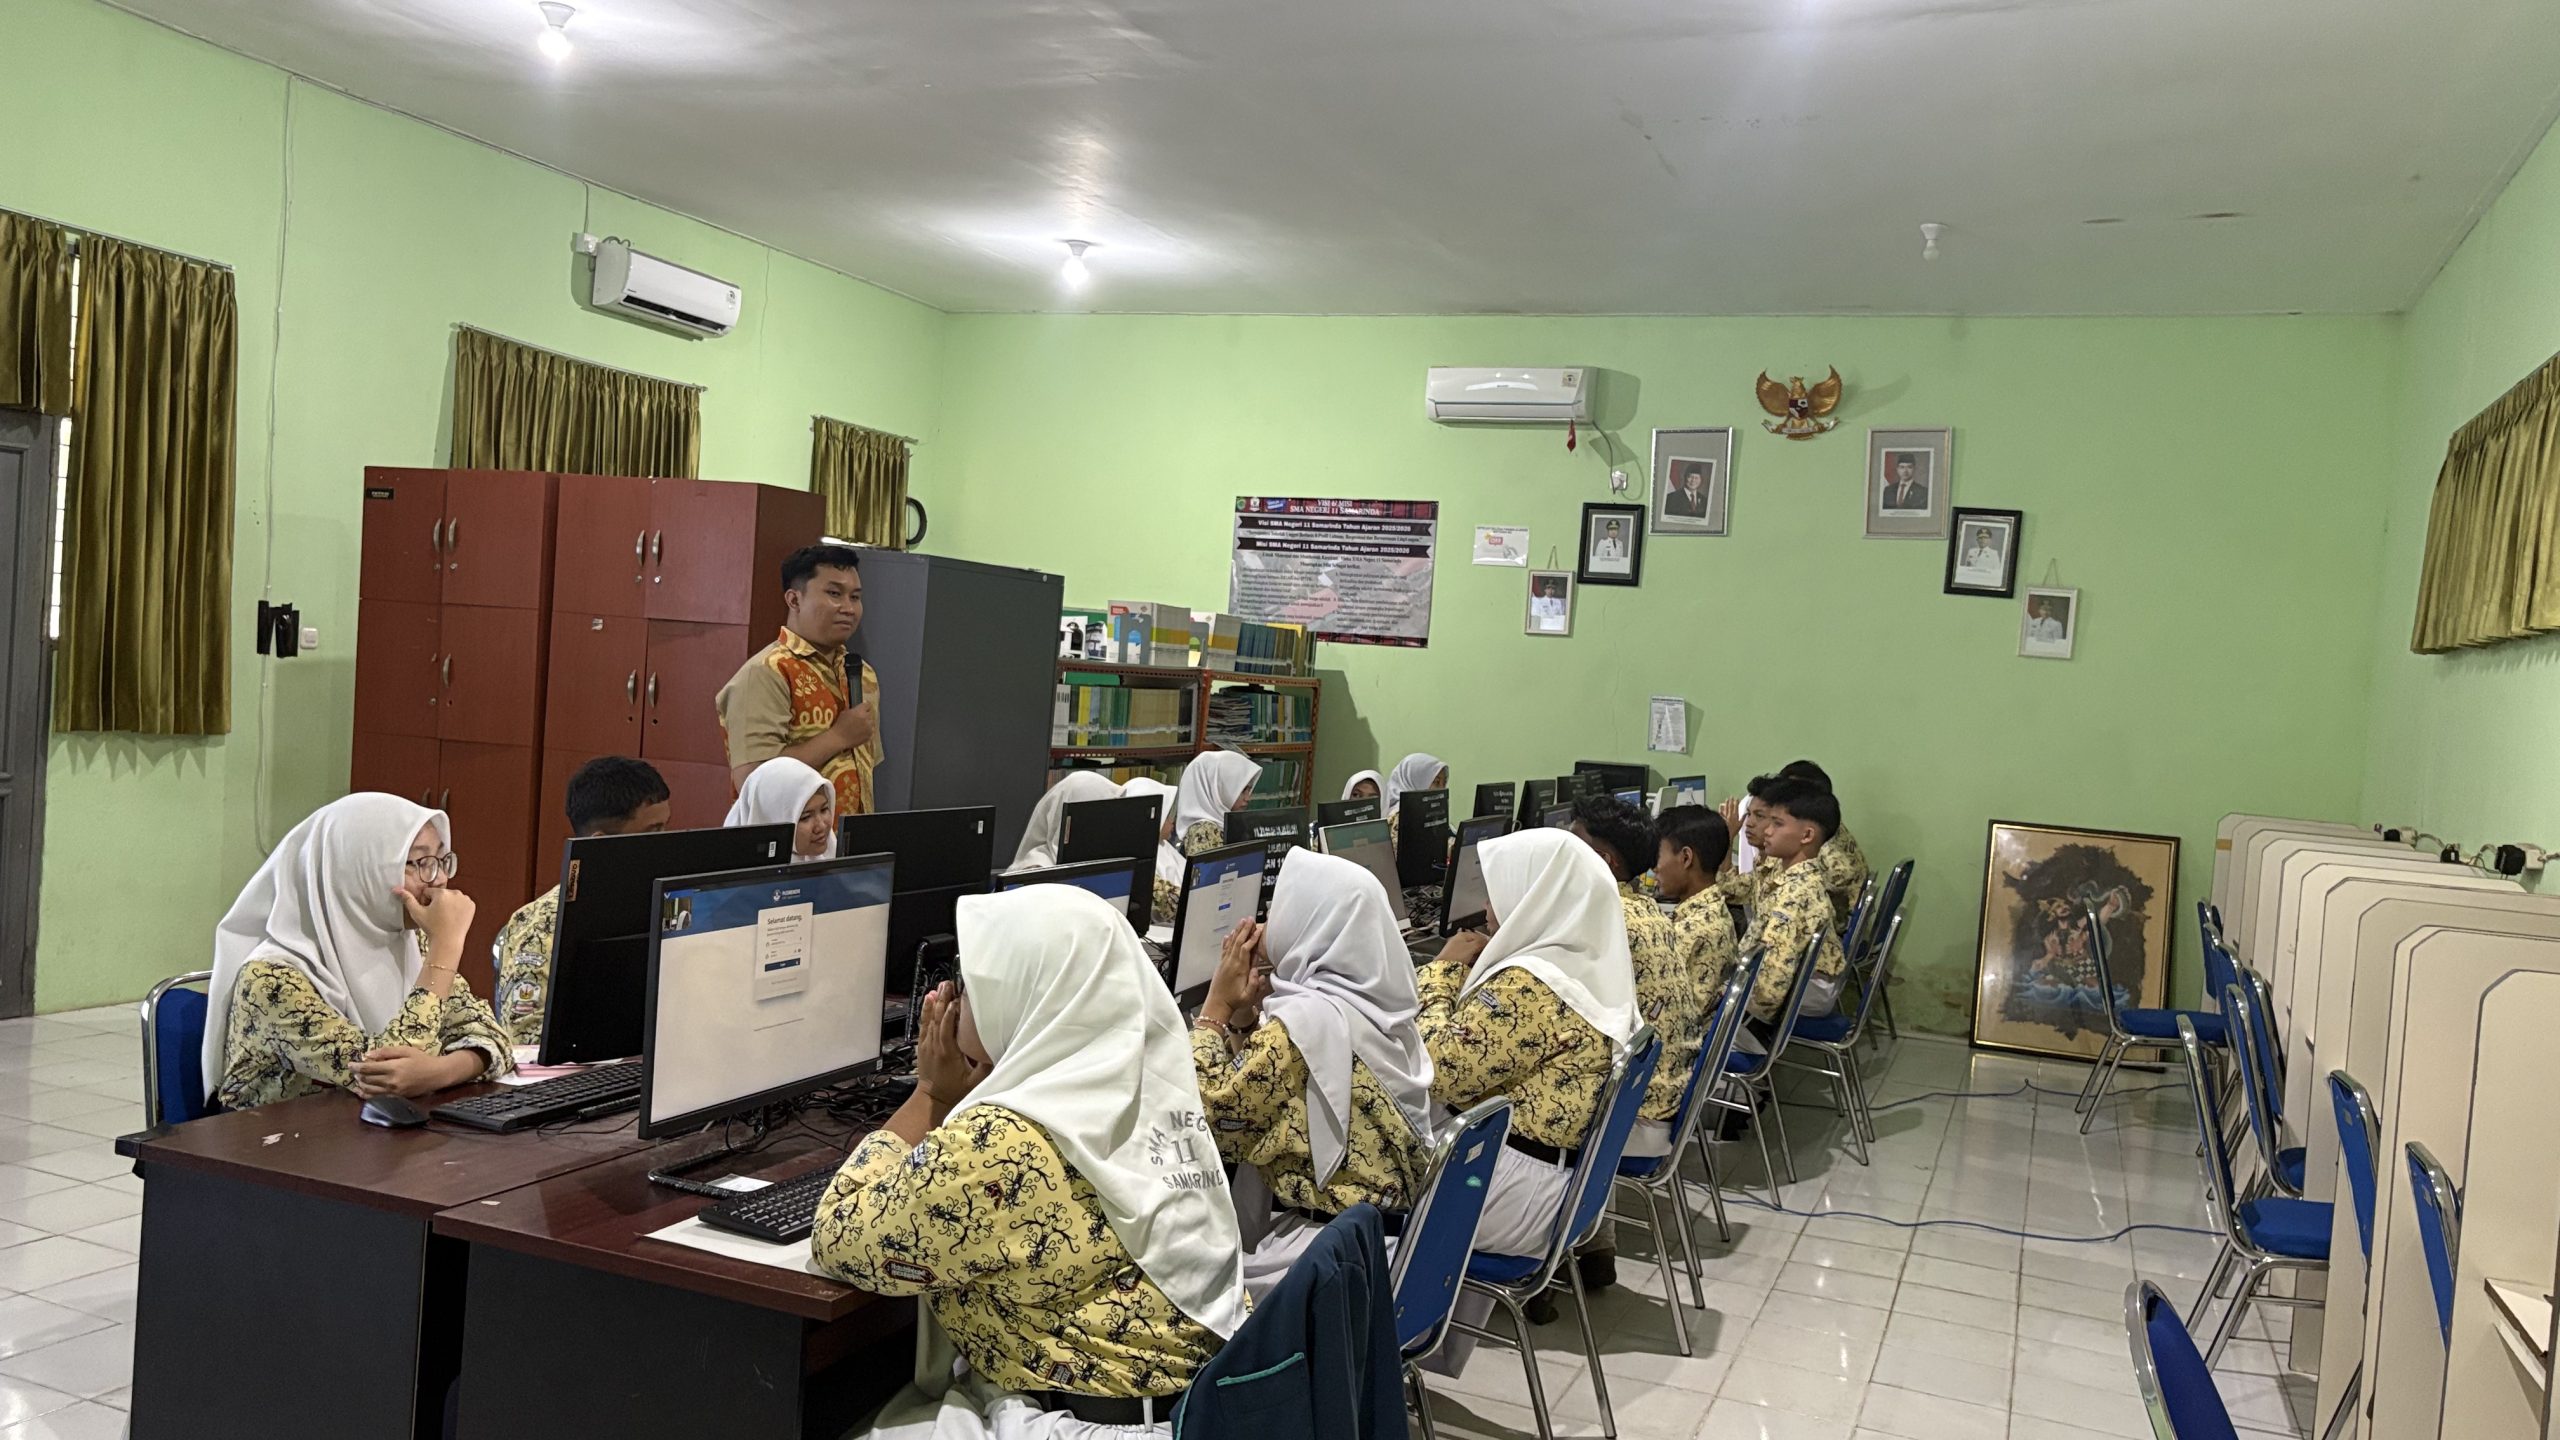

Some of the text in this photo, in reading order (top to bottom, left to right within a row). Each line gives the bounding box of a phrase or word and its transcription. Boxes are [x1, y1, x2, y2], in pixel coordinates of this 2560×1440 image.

[1305, 506, 1330, 514] NEGERI
[1283, 521, 1303, 529] Negeri
[1361, 524, 1381, 532] Ajaran
[1282, 542, 1301, 550] Negeri
[1310, 543, 1341, 551] Samarinda
[767, 916, 786, 925] Selamat
[1148, 1110, 1208, 1166] SMA NEG
[1171, 1136, 1198, 1164] 11
[1162, 1169, 1224, 1190] SAMARIND
